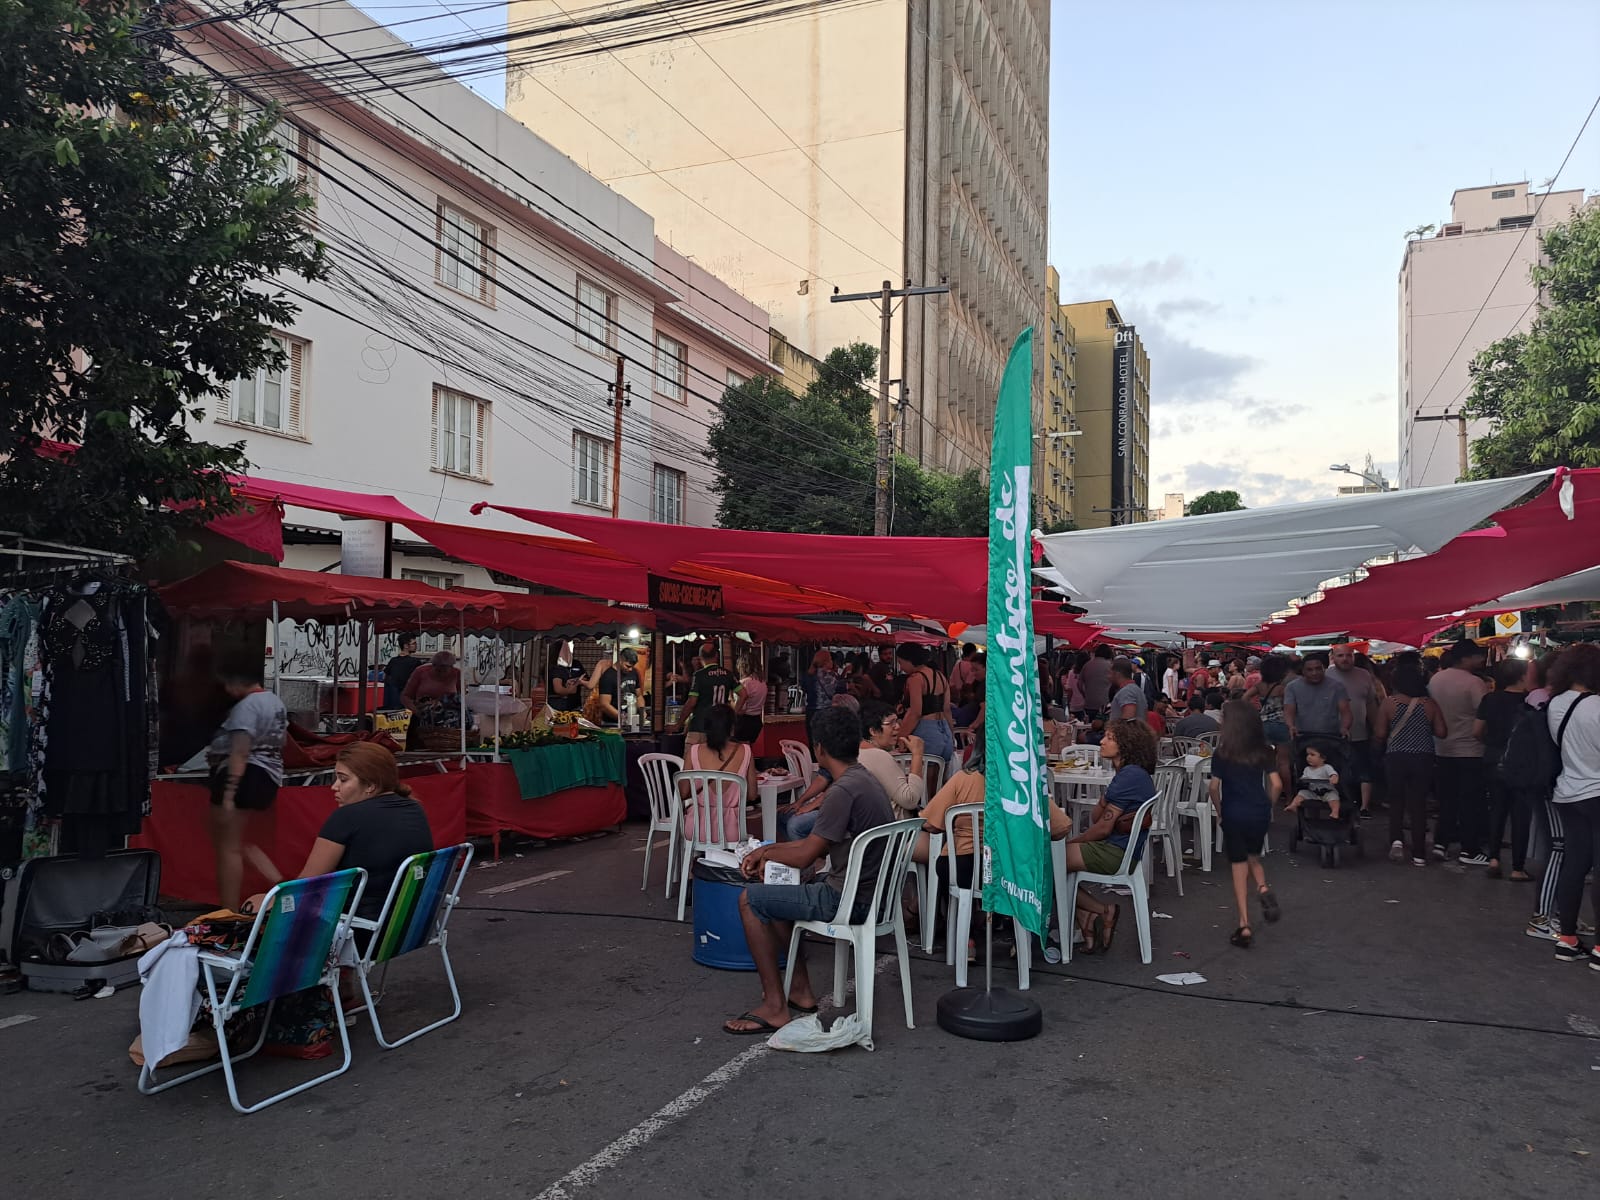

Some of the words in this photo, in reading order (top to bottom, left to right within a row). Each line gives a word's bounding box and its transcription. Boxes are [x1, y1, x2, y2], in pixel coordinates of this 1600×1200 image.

[1119, 352, 1129, 385] HOTEL
[1118, 387, 1128, 436] CONRADO
[1118, 439, 1127, 457] SAN
[711, 685, 726, 707] 10
